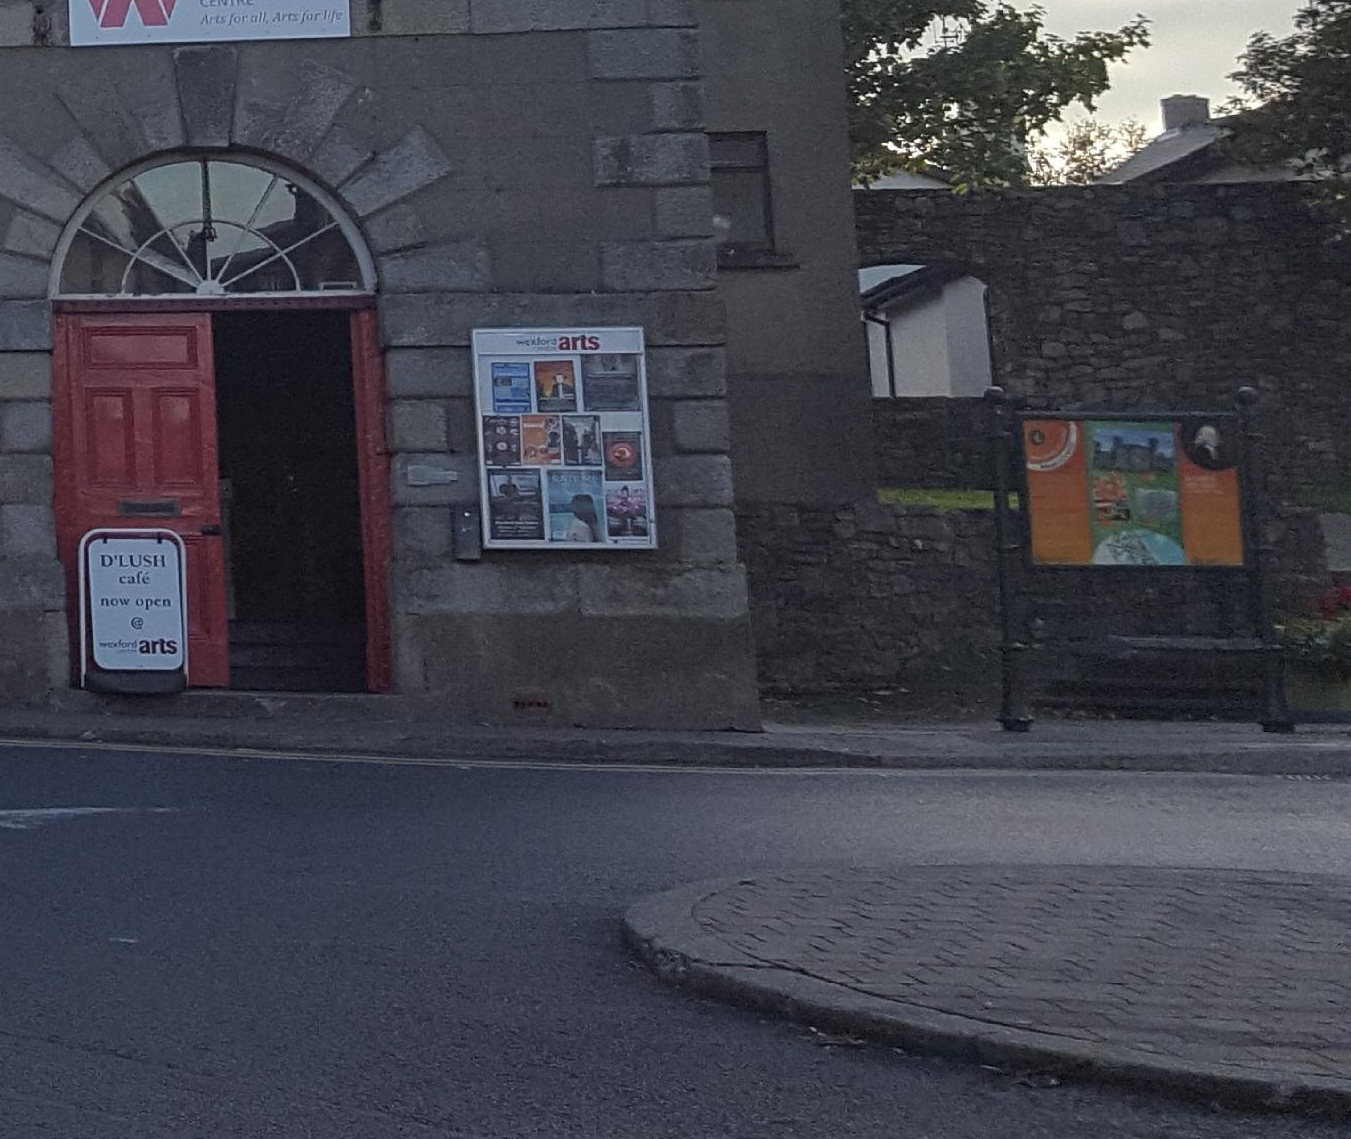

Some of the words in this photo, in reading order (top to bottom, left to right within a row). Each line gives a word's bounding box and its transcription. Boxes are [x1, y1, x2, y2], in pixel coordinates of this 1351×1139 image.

[199, 12, 227, 25] Arts
[228, 12, 248, 26] for
[250, 11, 269, 25] all,
[272, 10, 298, 23] Arts
[323, 9, 344, 24] life
[558, 334, 601, 351] arts
[100, 554, 166, 568] D'LUSH
[100, 597, 130, 607] now
[135, 597, 172, 610] open
[130, 616, 144, 630] @
[99, 639, 138, 649] wexford
[138, 637, 178, 655] arts
